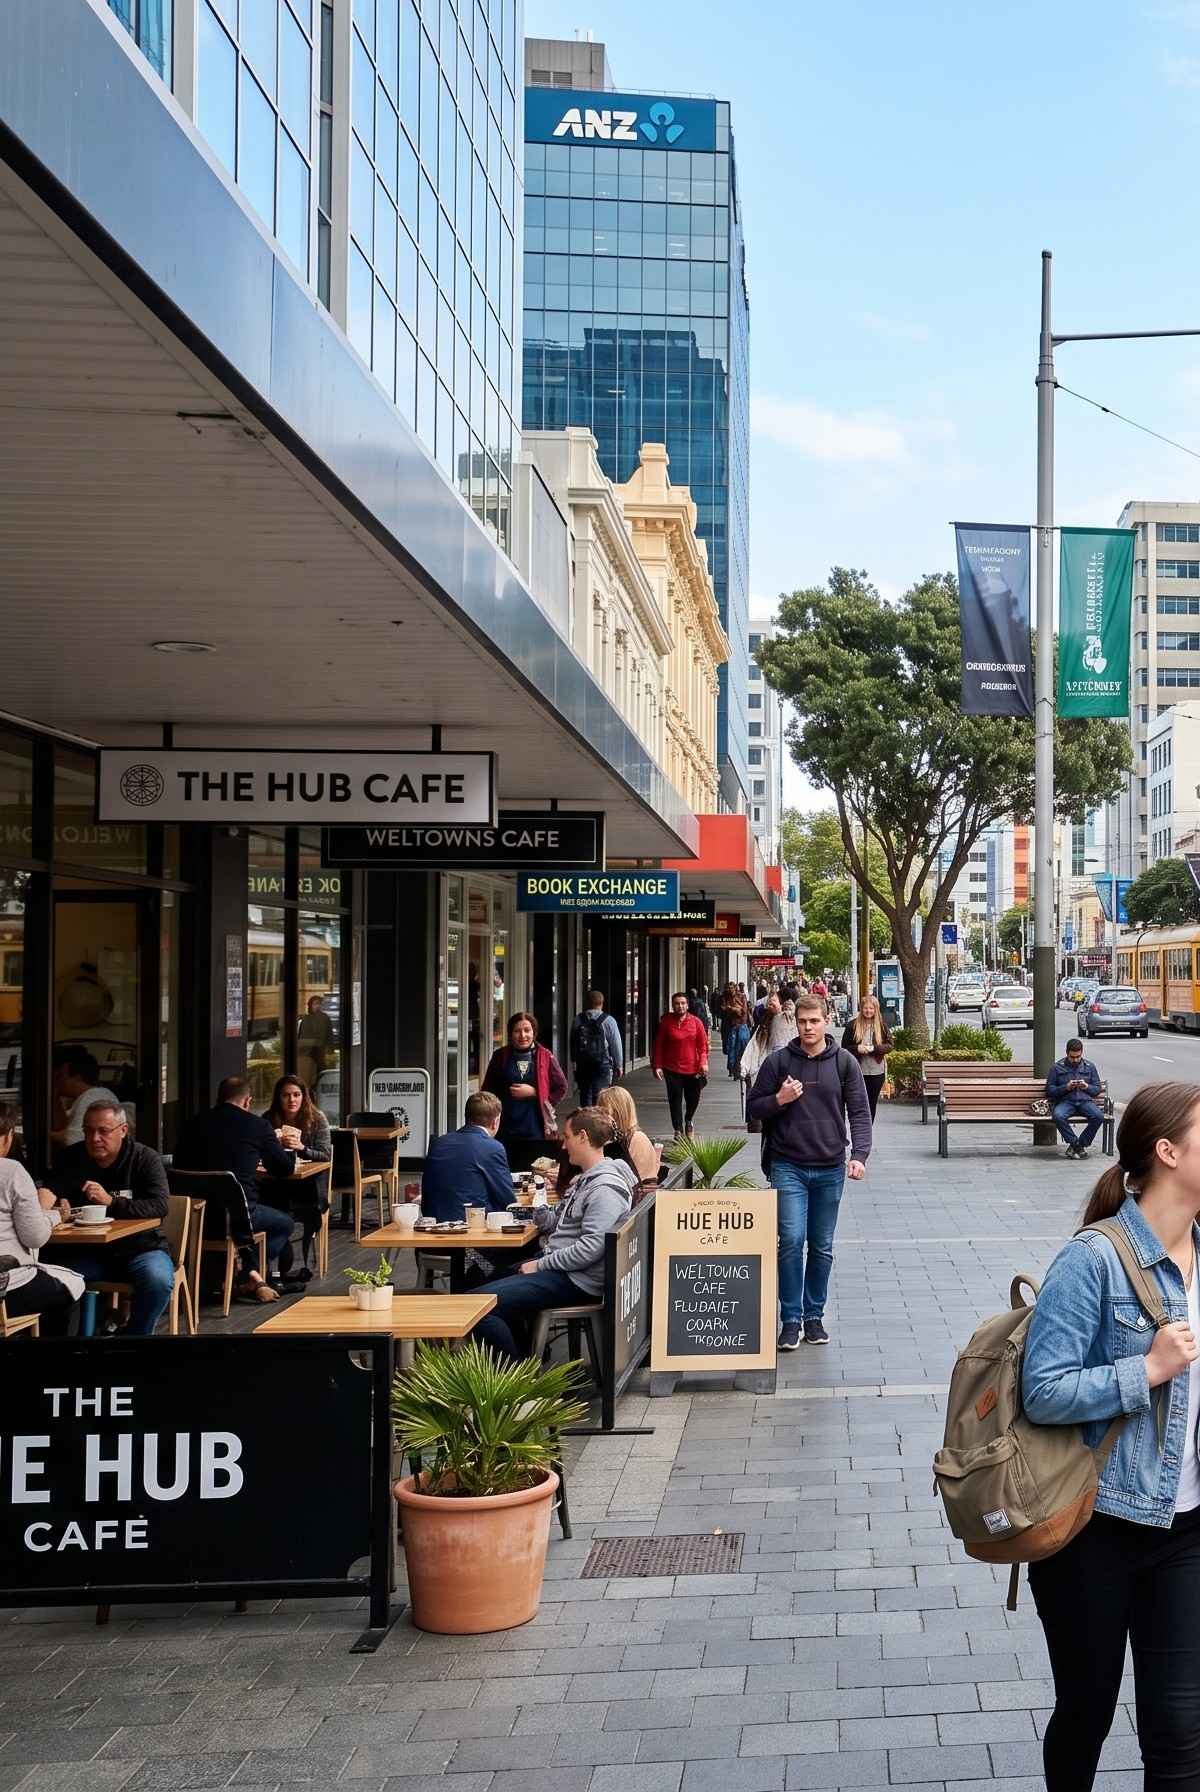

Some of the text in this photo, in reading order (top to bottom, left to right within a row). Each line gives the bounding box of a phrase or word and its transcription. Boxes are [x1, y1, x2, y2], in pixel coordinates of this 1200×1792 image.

[553, 108, 638, 141] ANZ
[177, 771, 465, 804] THE HUB CAFE
[366, 829, 560, 848] WELTOWNS CAFE
[527, 878, 667, 895] BOOK EXCHANGE
[677, 1212, 754, 1230] HUE HUB
[693, 1281, 727, 1295] CAFE
[43, 1387, 134, 1417] THE
[85, 1431, 244, 1502] HUB
